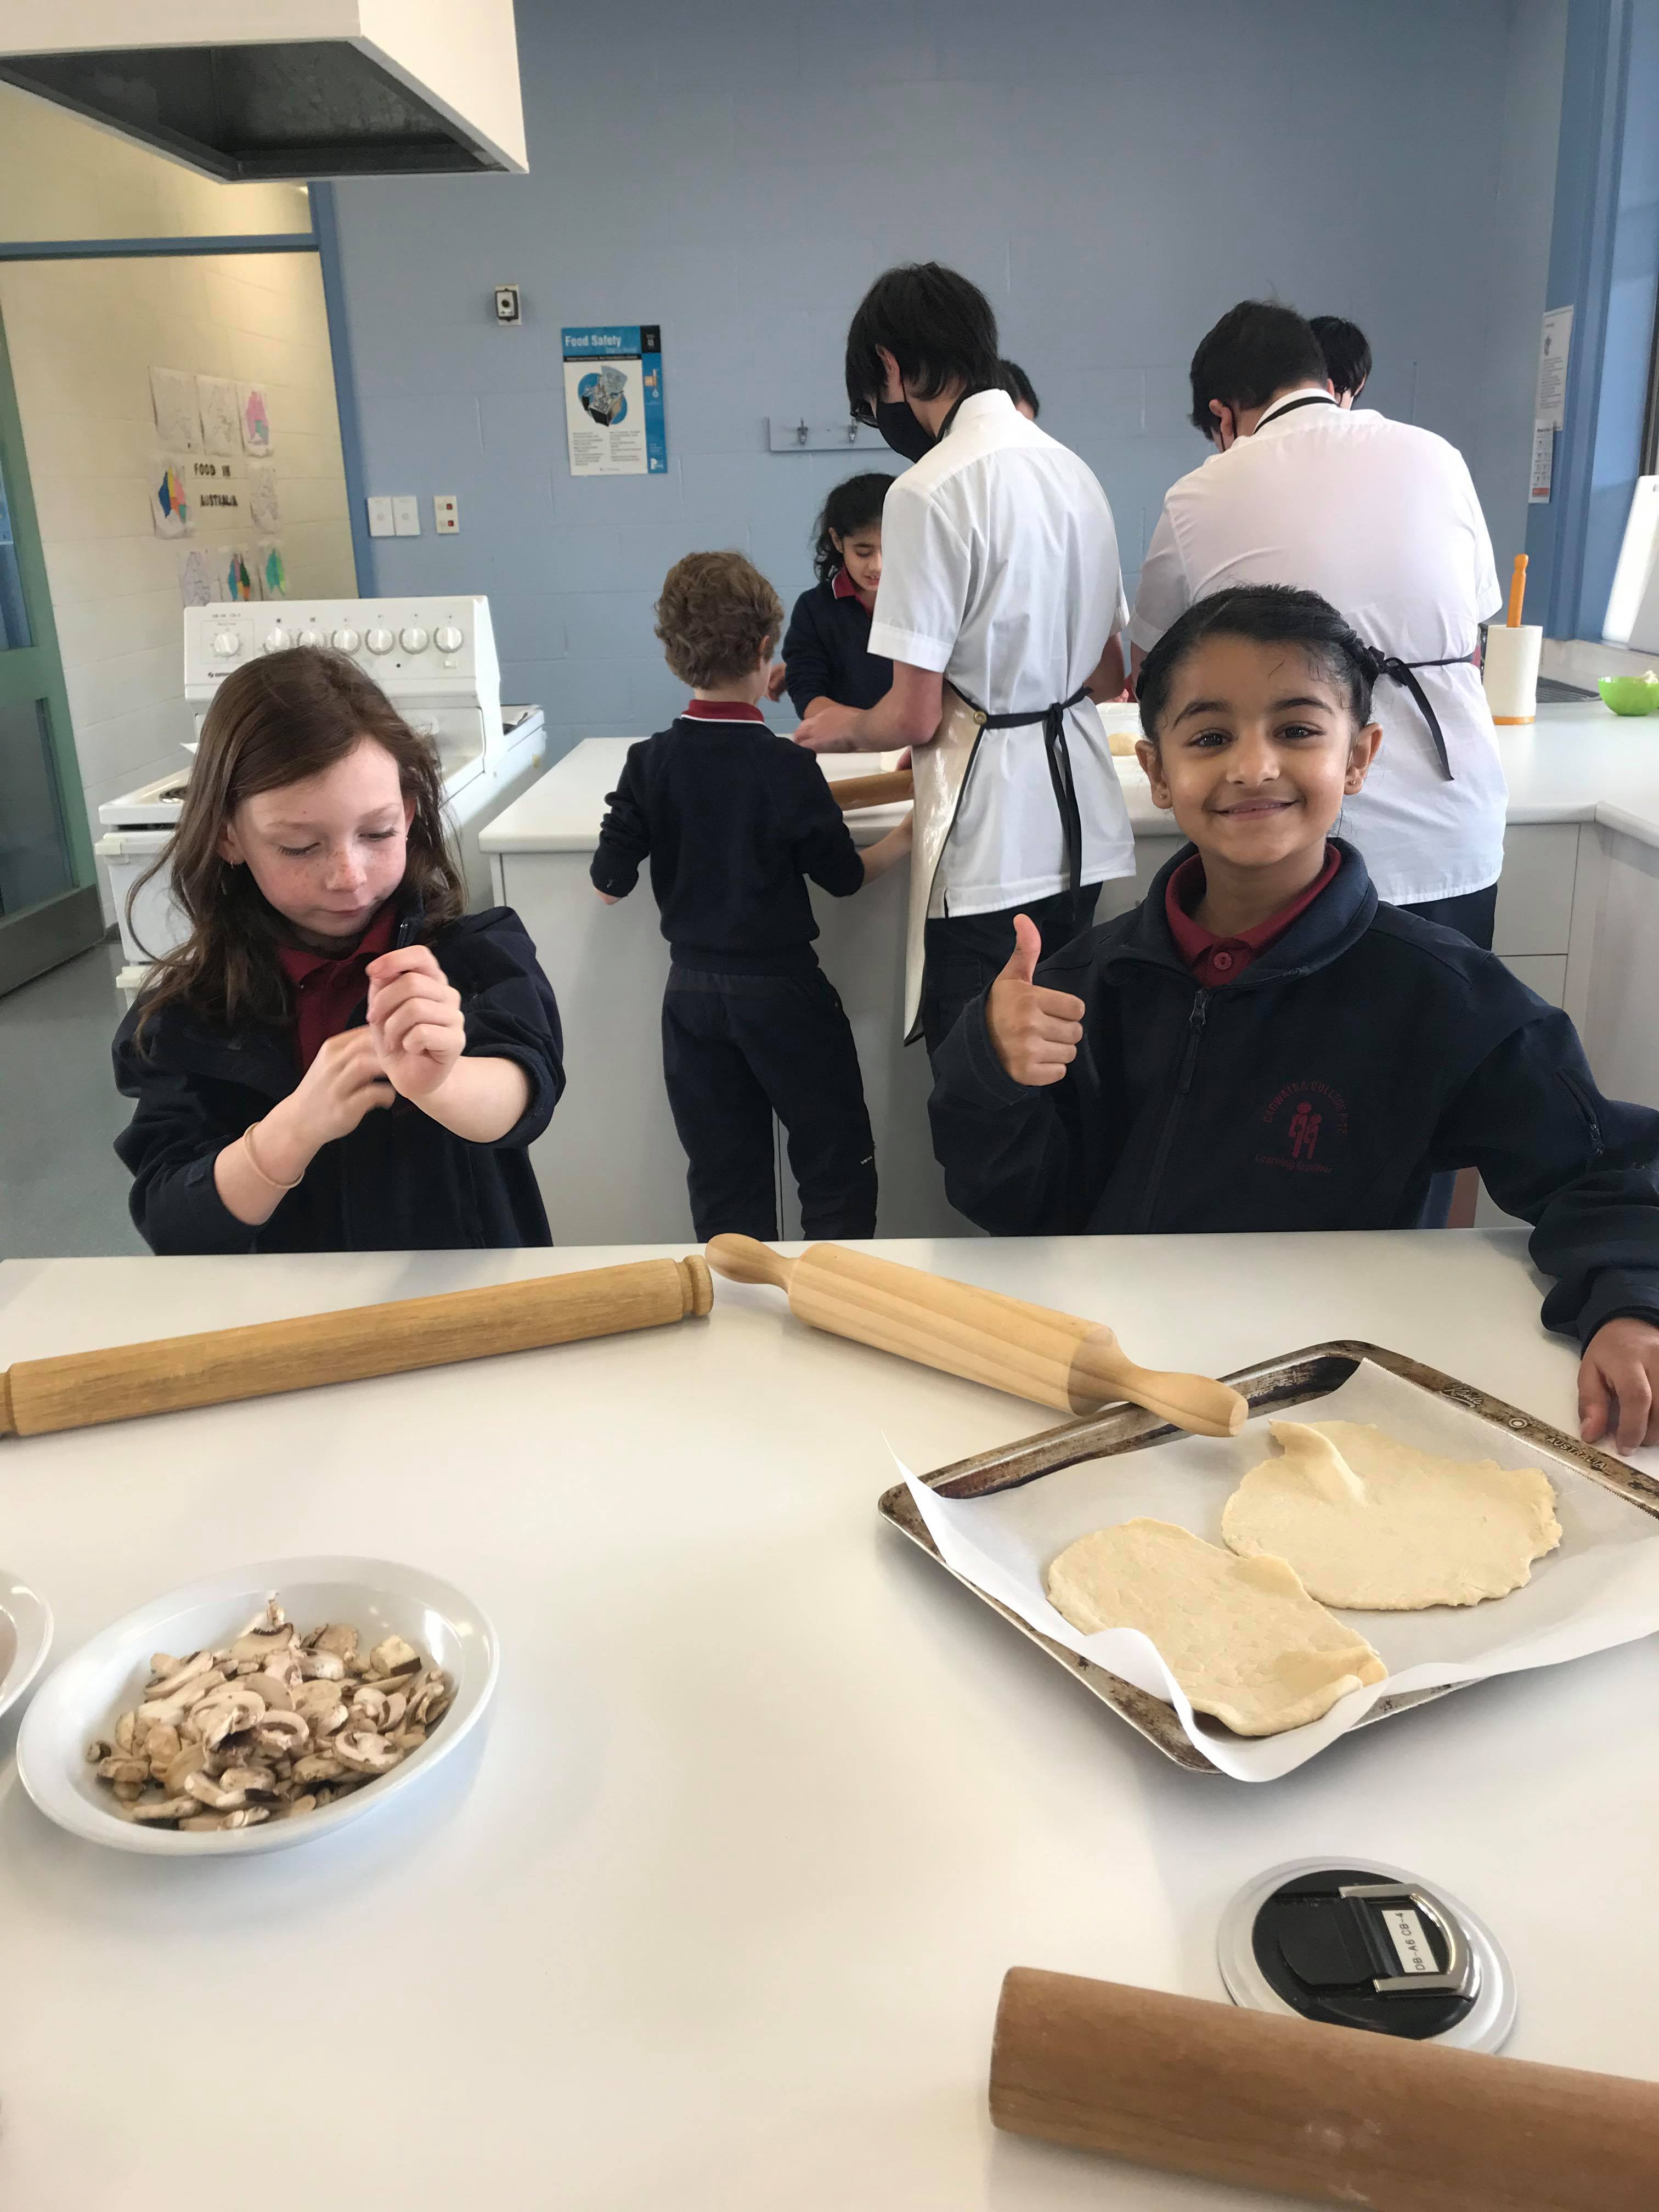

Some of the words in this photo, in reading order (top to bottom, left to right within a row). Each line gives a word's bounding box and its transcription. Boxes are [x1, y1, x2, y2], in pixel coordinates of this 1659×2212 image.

[565, 335, 589, 347] Food
[591, 335, 622, 347] Safety
[194, 462, 216, 475] FOOD
[1546, 1436, 1607, 1470] AUSTRALIA
[1395, 1912, 1412, 1937] CB-4
[1408, 1939, 1426, 1971] DB-A6
